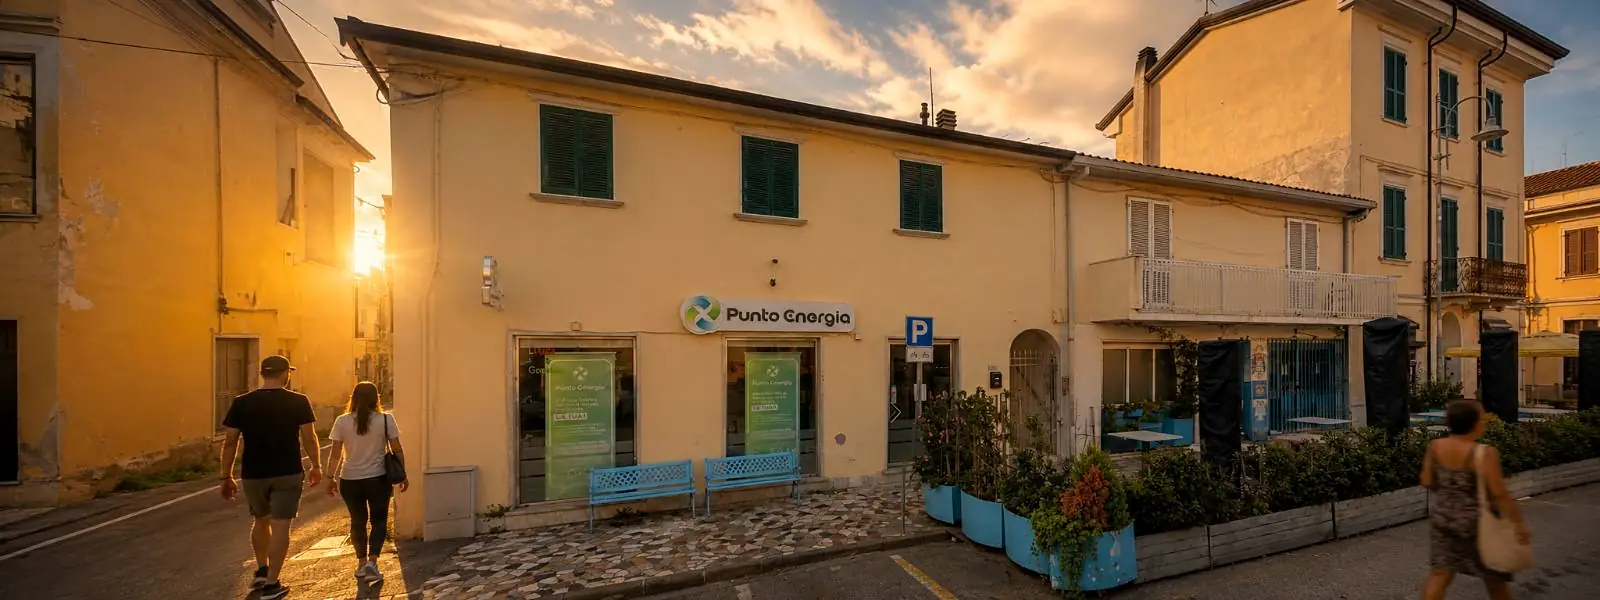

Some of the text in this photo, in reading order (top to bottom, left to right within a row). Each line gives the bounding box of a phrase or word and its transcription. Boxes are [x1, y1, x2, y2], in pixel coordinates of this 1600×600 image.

[727, 308, 851, 327] Punto Energia
[912, 319, 928, 344] P
